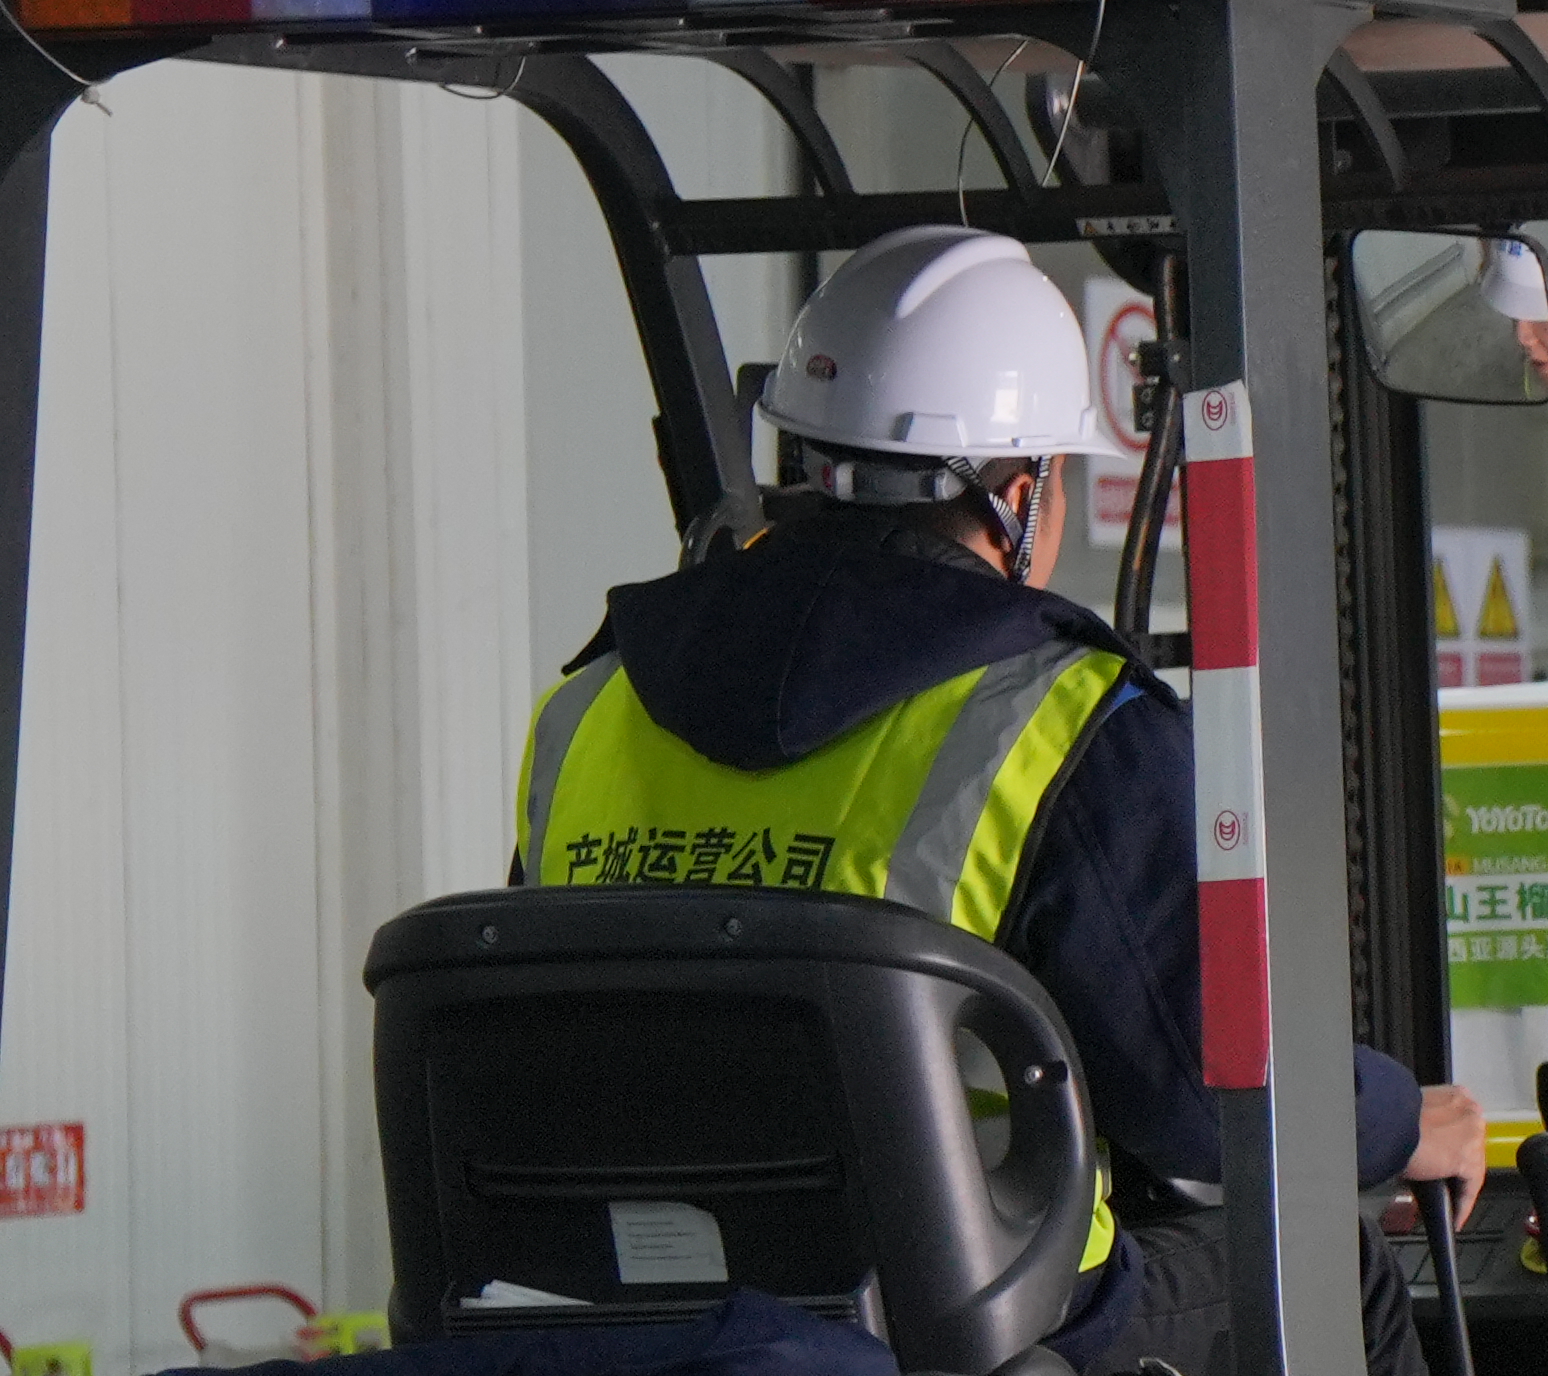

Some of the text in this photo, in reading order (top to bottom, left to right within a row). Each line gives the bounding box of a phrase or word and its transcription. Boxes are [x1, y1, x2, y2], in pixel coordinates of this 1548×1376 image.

[566, 826, 837, 891] 产城运营公司
